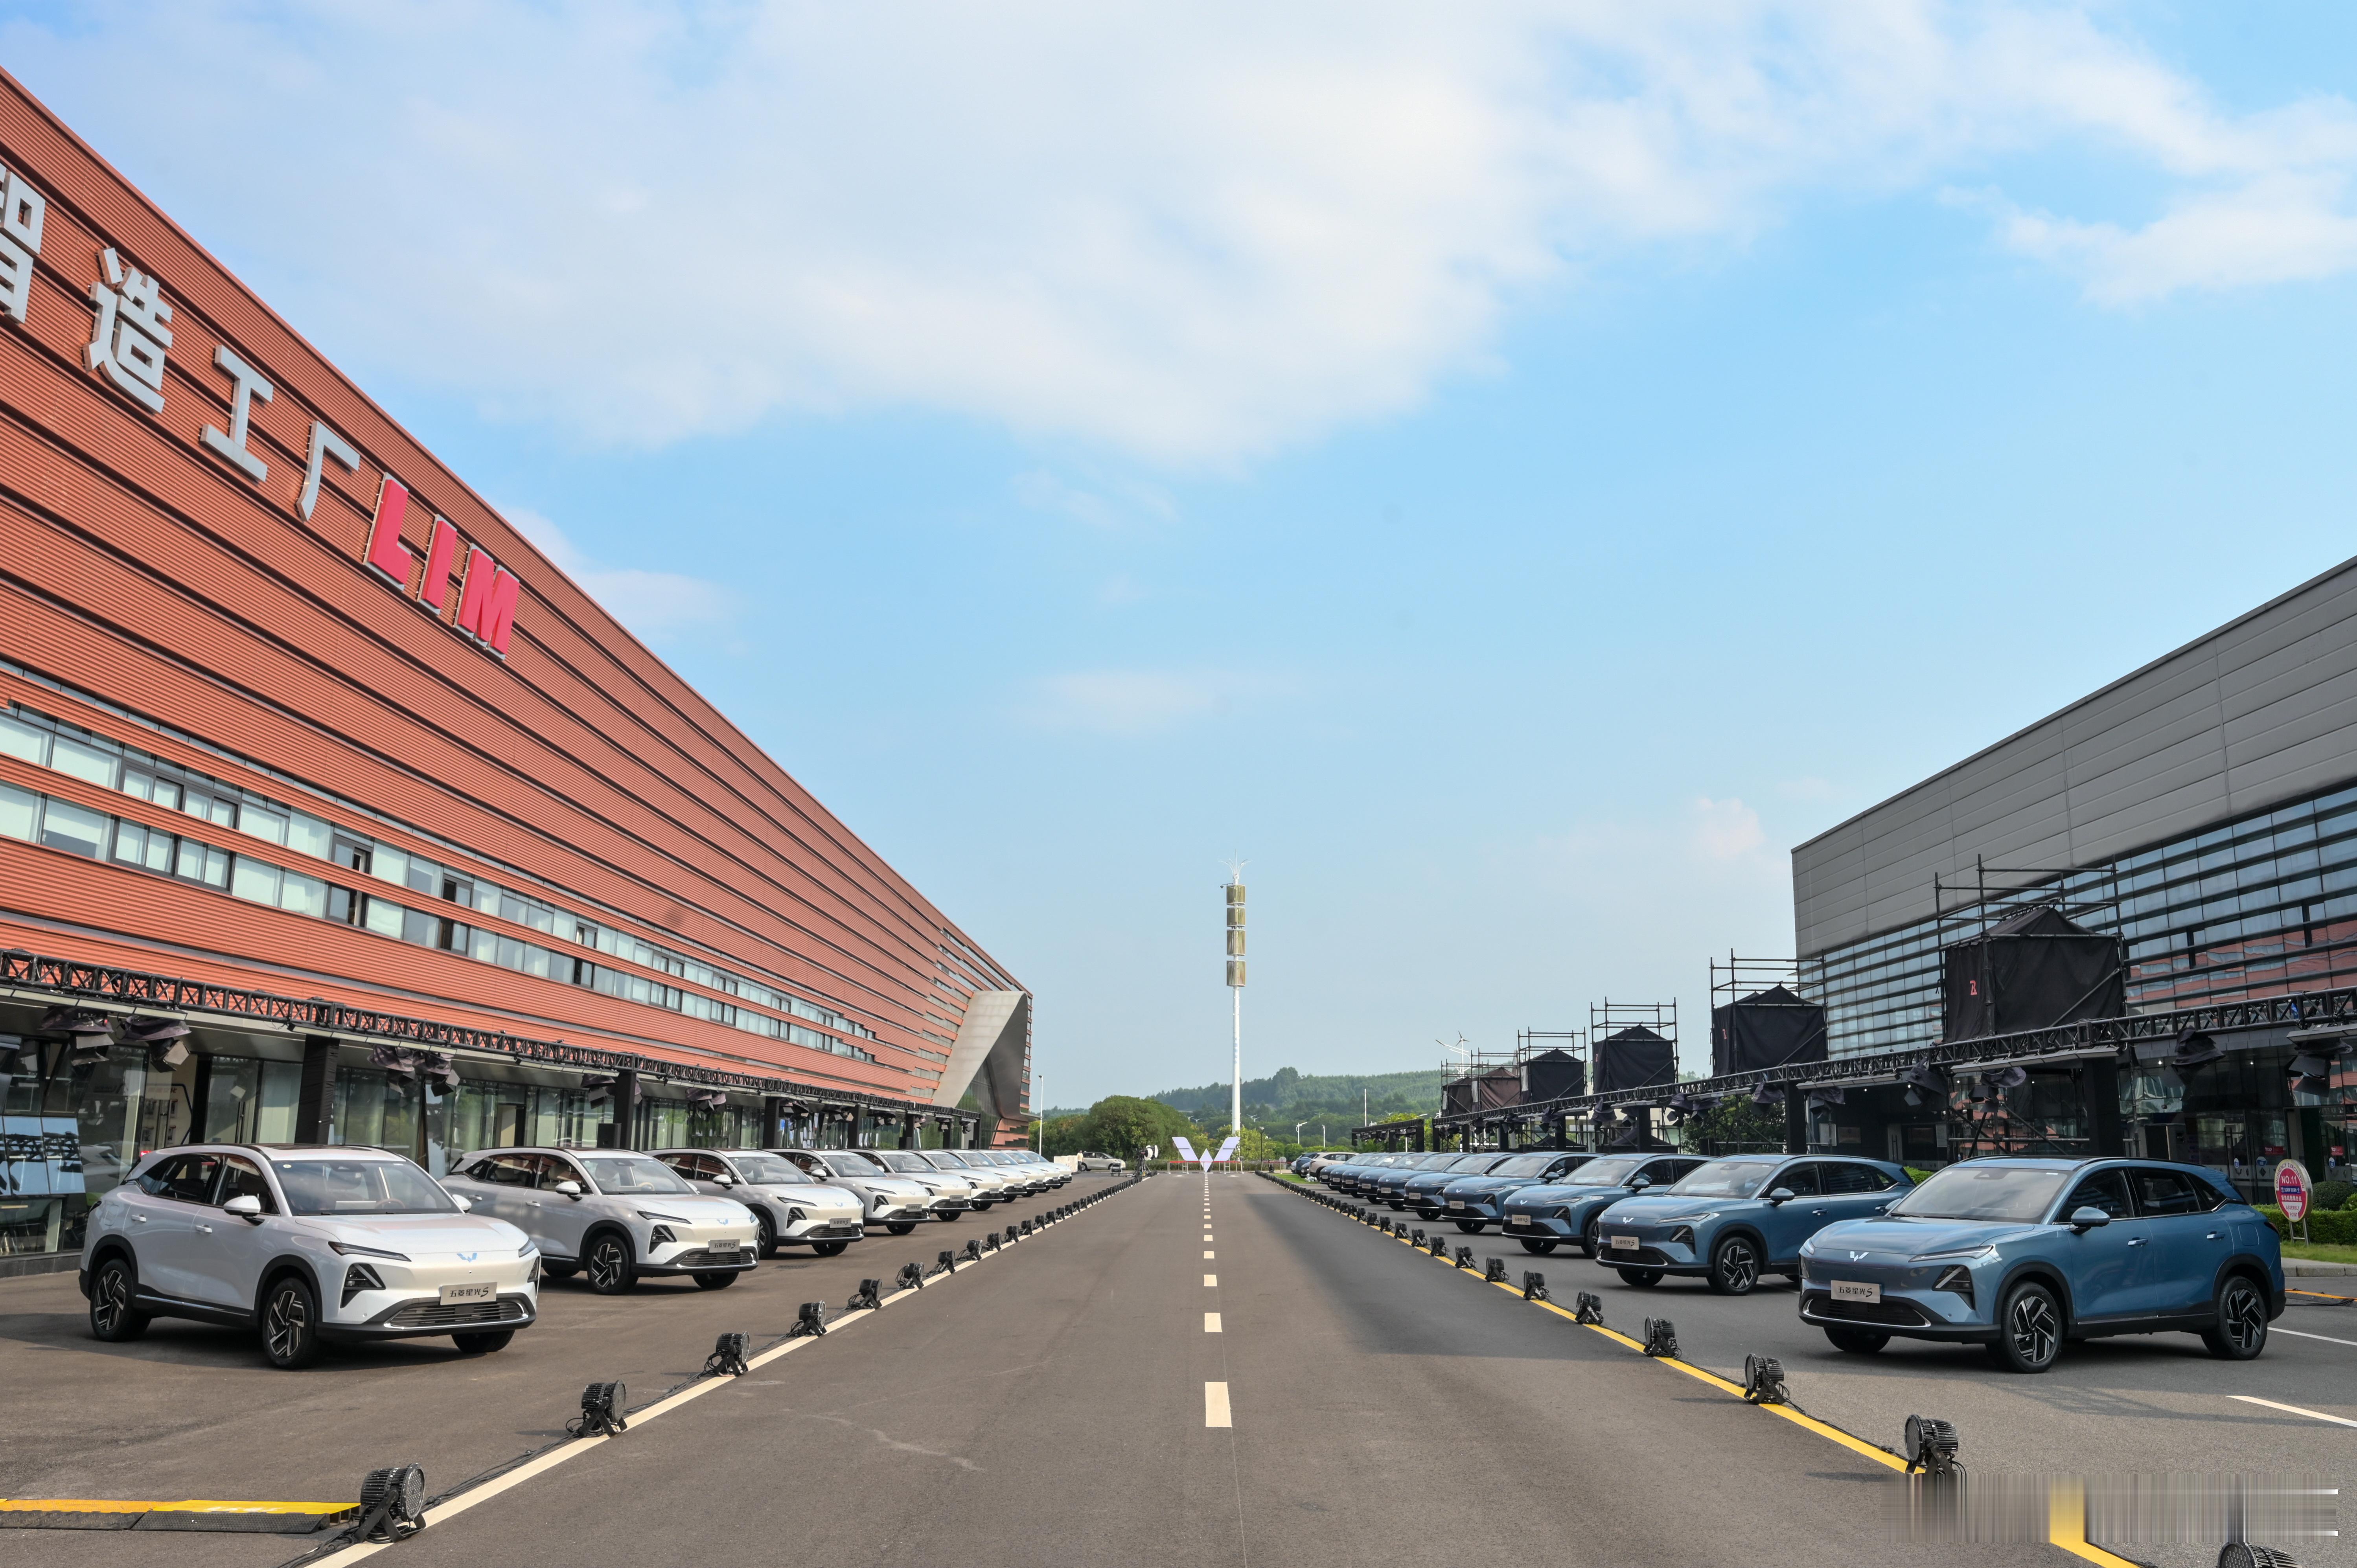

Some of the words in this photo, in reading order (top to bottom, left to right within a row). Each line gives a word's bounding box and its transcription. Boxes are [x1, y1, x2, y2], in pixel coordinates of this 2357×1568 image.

[363, 472, 520, 661] LIM
[2276, 1163, 2286, 1188] EMERGENCY
[2288, 1163, 2304, 1189] EVACUATION
[2281, 1175, 2297, 1184] NO.11
